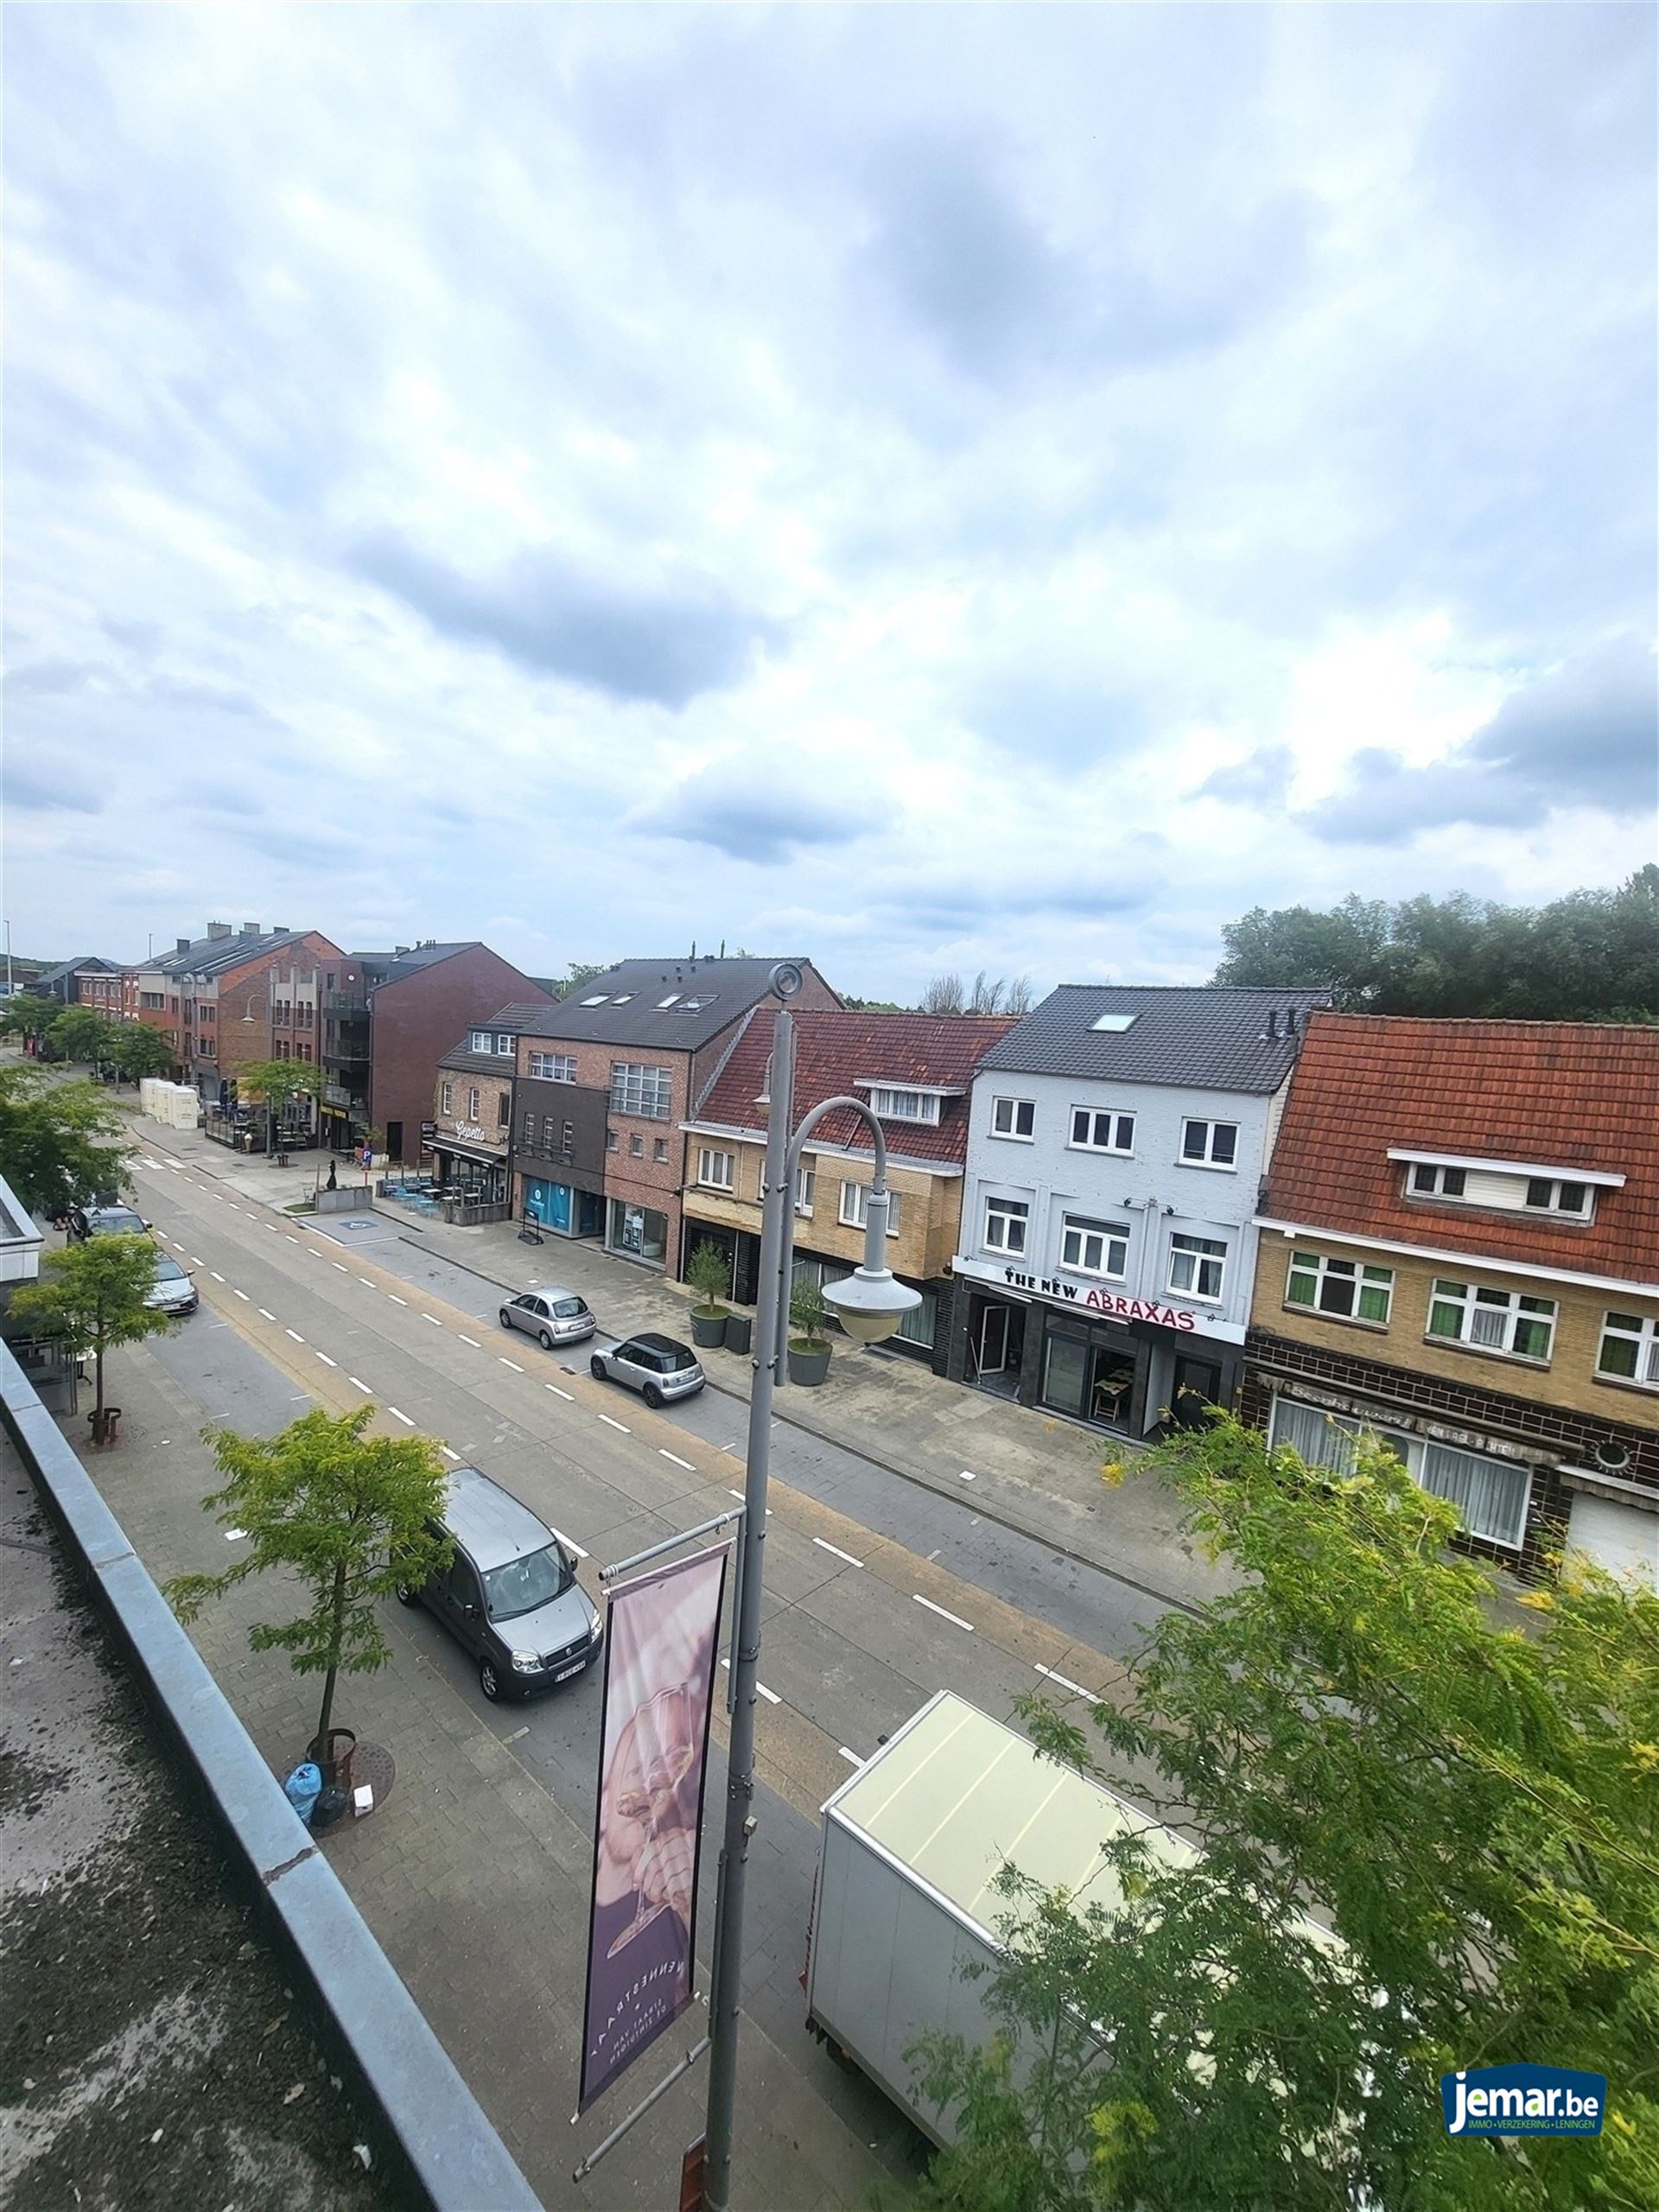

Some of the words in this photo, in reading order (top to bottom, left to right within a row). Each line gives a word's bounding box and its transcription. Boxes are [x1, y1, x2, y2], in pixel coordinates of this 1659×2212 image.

[455, 1120, 486, 1141] Gepetto
[363, 1150, 372, 1160] P
[1005, 1271, 1036, 1290] THE
[1041, 1279, 1078, 1300] NEW
[1086, 1289, 1196, 1331] ABRAXAS
